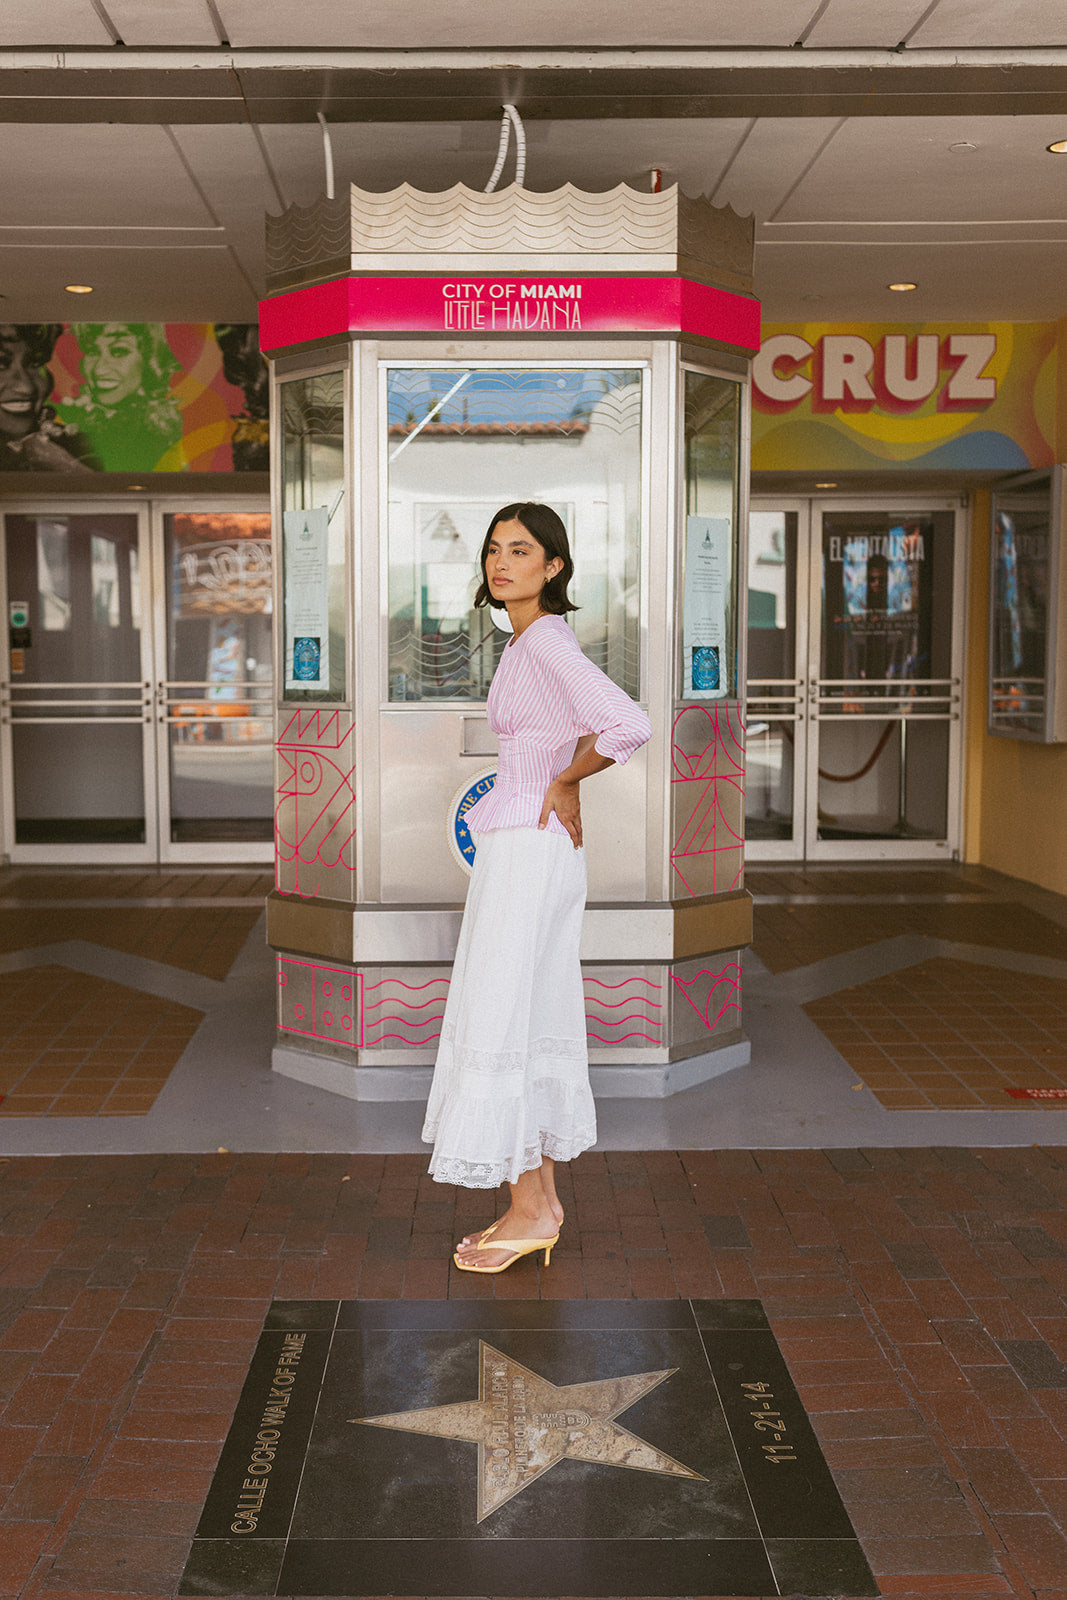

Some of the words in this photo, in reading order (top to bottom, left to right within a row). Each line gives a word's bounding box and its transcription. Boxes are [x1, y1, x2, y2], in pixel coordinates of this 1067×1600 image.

[442, 284, 485, 298] CITY
[489, 284, 516, 298] OF
[520, 284, 582, 299] MIAMI
[444, 300, 485, 329] LITTLE
[491, 300, 582, 329] HAVANA
[752, 333, 997, 412] CRUZ
[829, 535, 844, 562] EL
[846, 535, 925, 562] MENTALISTA
[457, 793, 478, 822] THE
[278, 1333, 307, 1365] FAME
[272, 1367, 297, 1386] OF
[260, 1387, 293, 1427] WALK
[740, 1381, 797, 1464] 11-21-14
[247, 1429, 281, 1475] OCHO
[230, 1477, 268, 1534] CALLE
